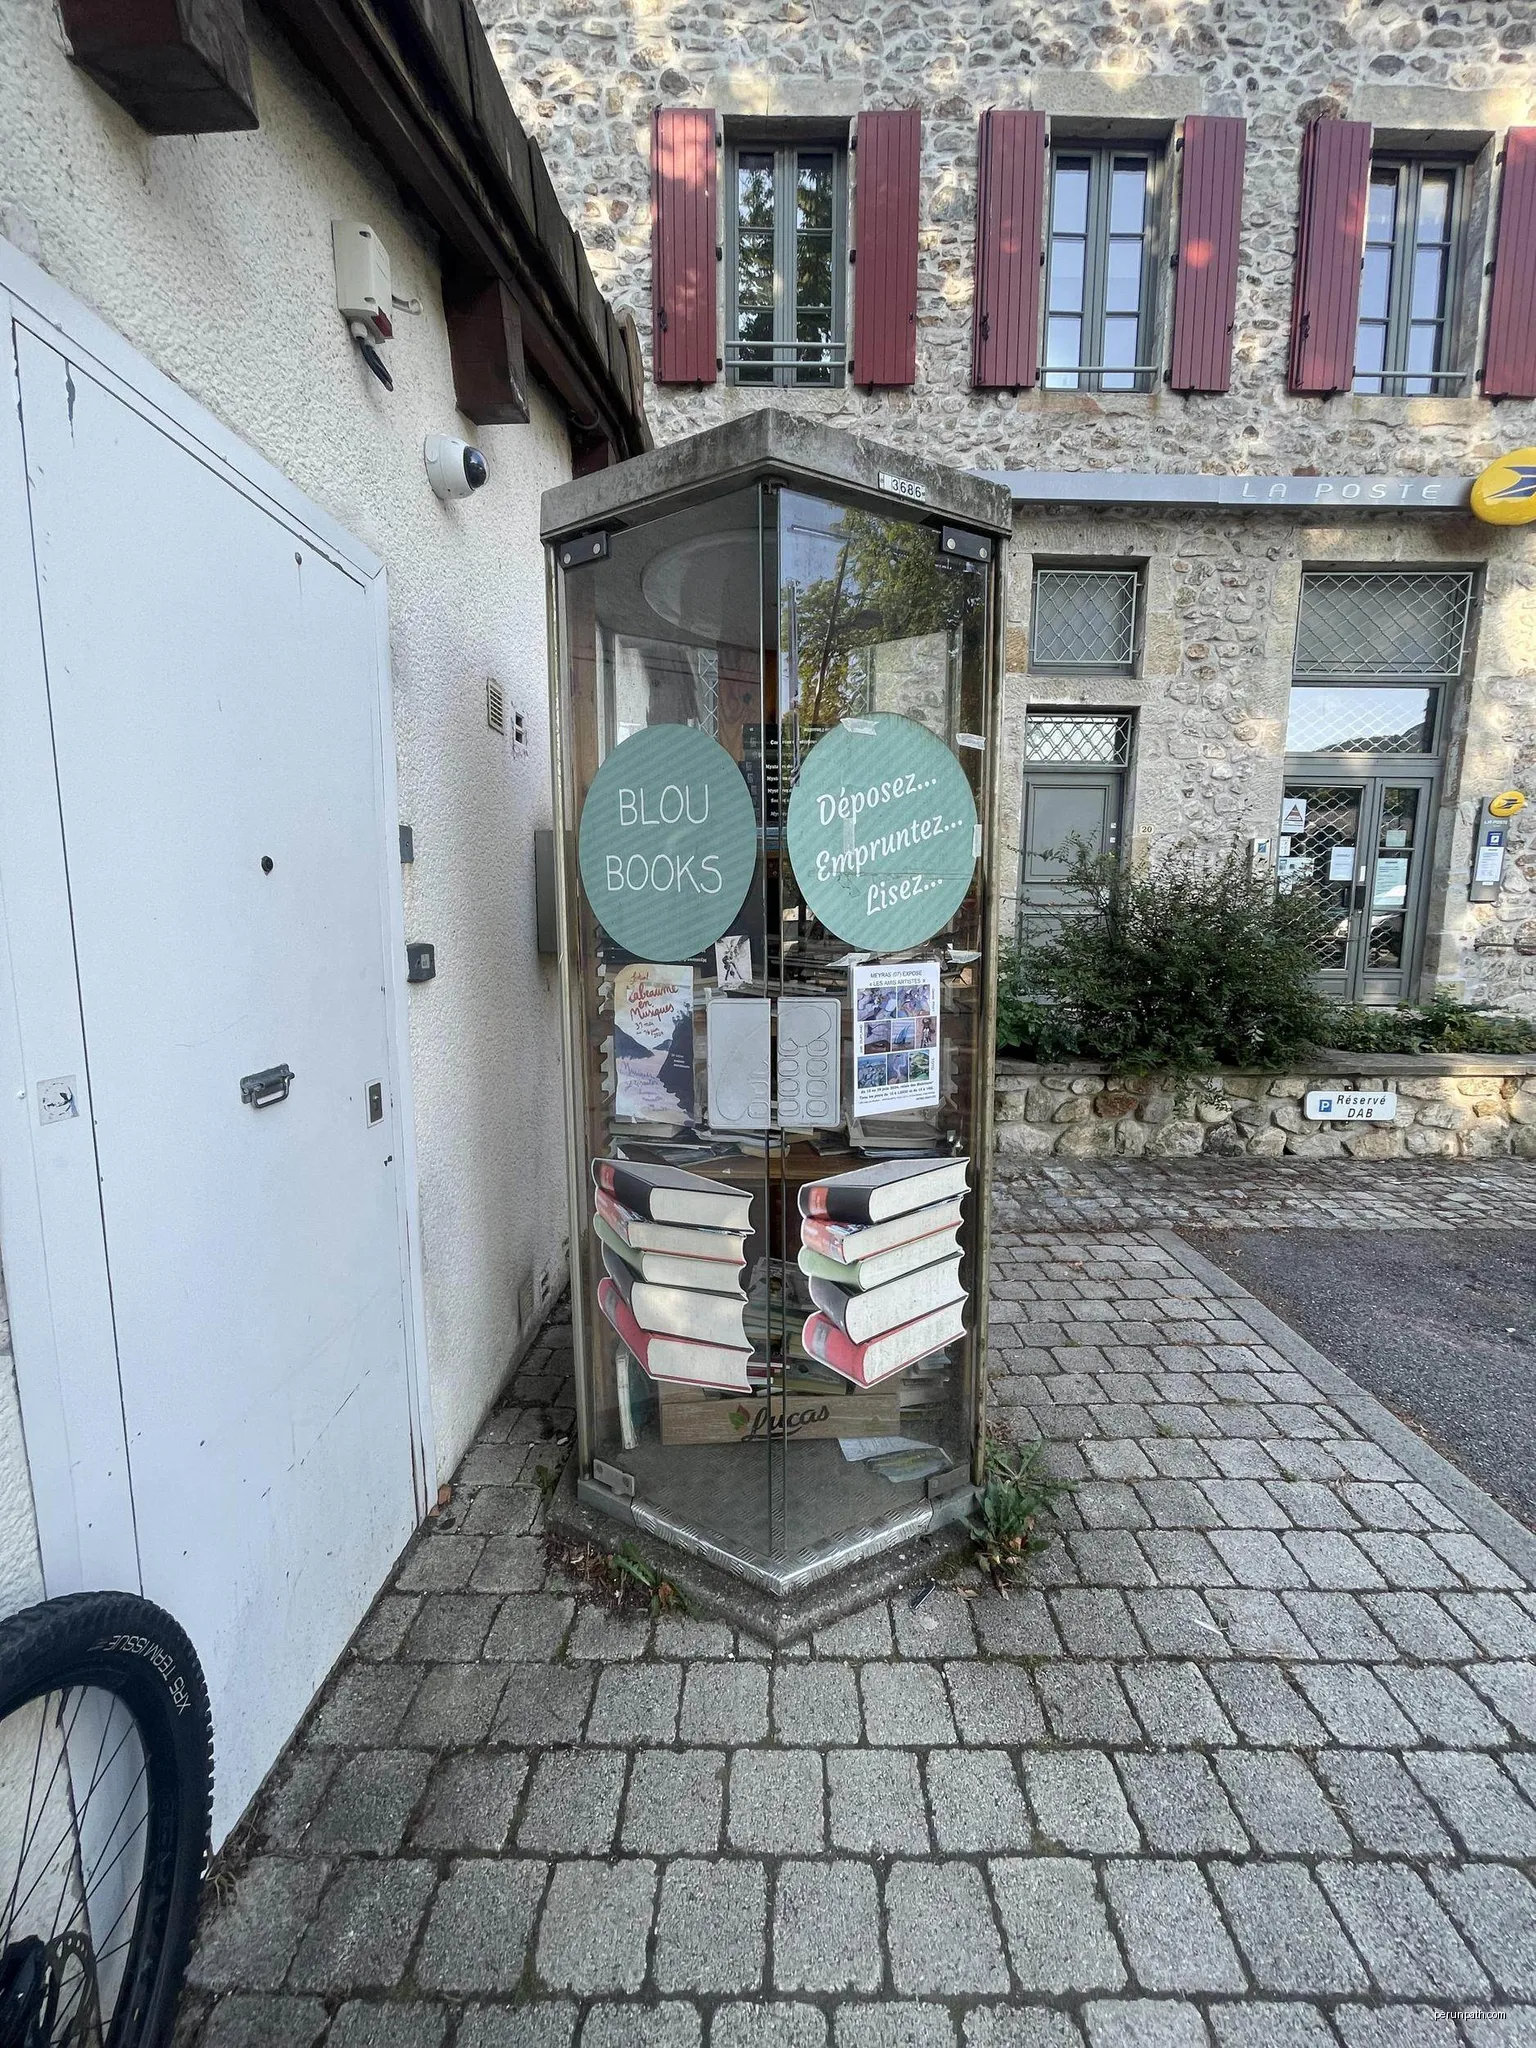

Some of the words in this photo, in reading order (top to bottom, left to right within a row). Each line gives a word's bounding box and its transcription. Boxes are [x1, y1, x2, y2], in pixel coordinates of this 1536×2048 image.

[892, 479, 922, 498] 3686
[1242, 482, 1287, 498] LA
[1315, 483, 1442, 500] POSTE
[619, 784, 709, 826] BLOU
[816, 773, 937, 826] Déposez...
[816, 815, 963, 881] Empruntez...
[606, 854, 723, 894] BOOKS
[866, 875, 943, 916] Lisez...
[638, 1000, 652, 1008] en
[1336, 1095, 1386, 1105] Réservé
[1348, 1108, 1373, 1118] DAB
[741, 1405, 830, 1442] Lucas
[103, 1634, 150, 1655] ISSUE
[143, 1642, 176, 1681] TEAM
